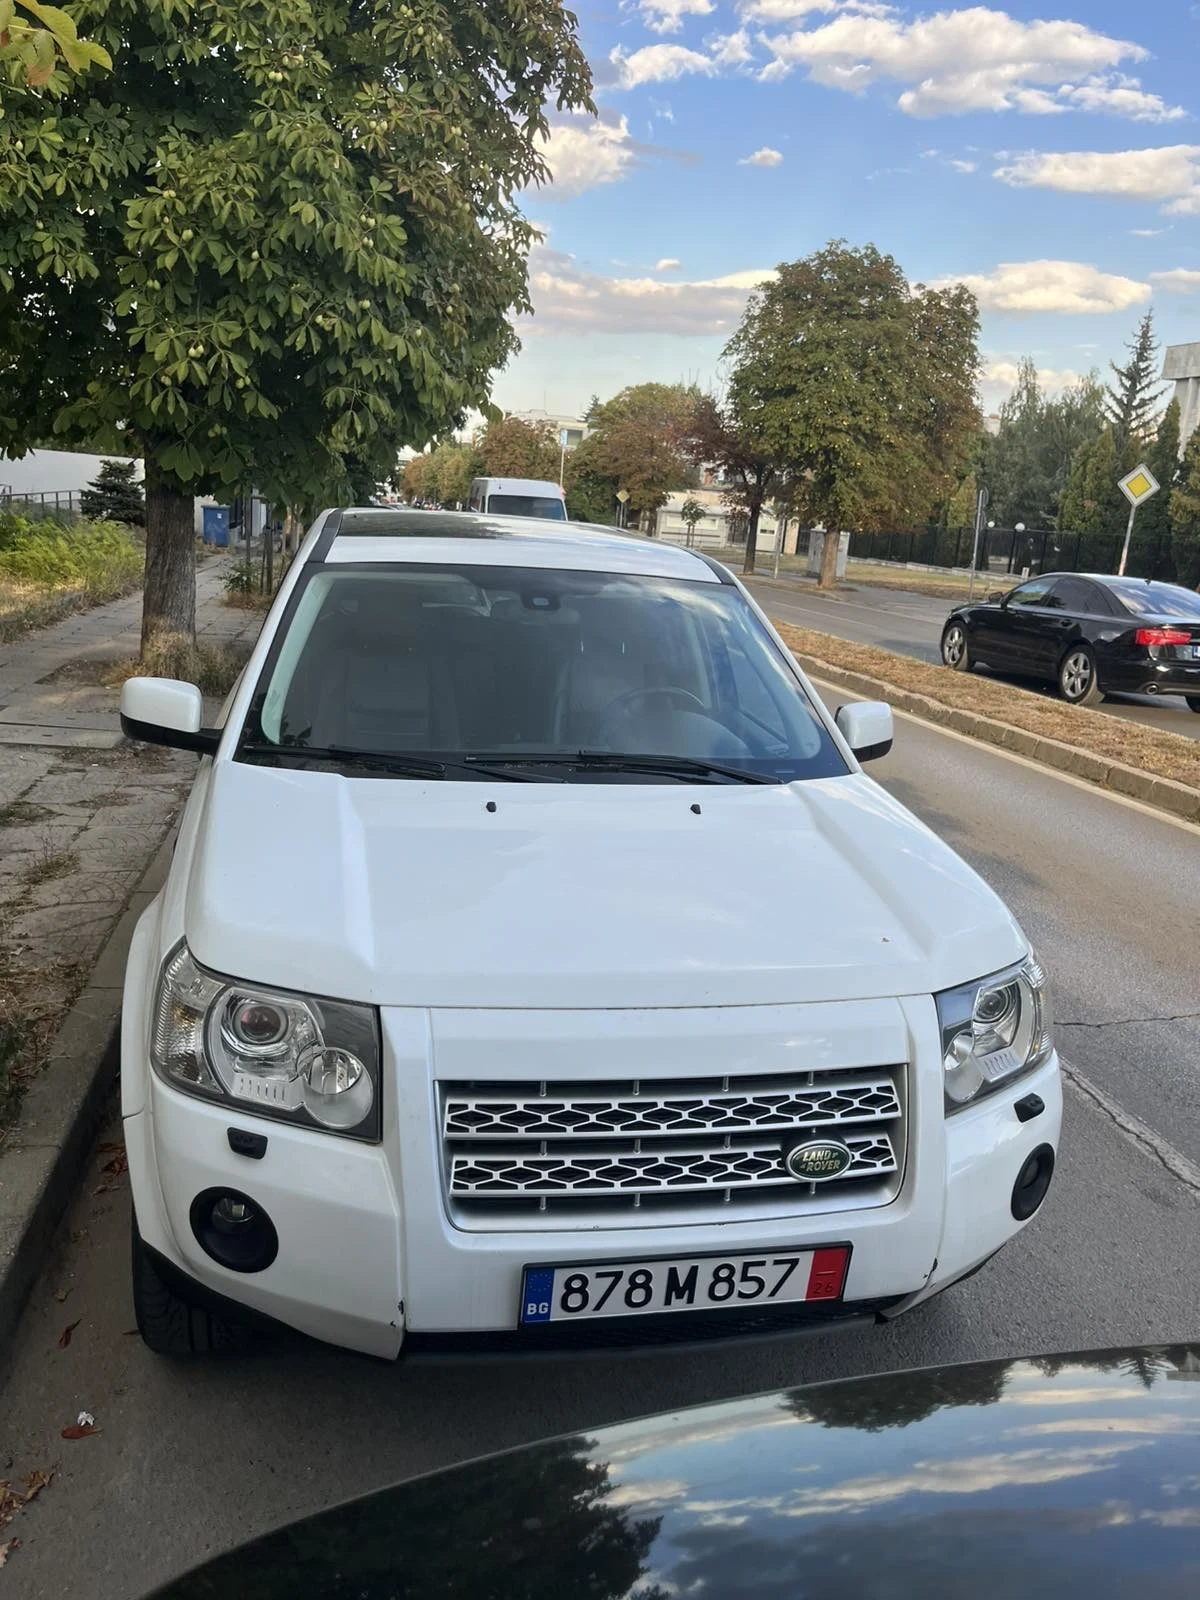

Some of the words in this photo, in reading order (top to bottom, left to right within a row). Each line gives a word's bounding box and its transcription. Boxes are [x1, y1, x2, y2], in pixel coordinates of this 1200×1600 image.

[803, 1150, 831, 1162] LAND
[806, 1160, 840, 1172] ROVER
[560, 1269, 653, 1313] 878
[664, 1265, 699, 1307] M
[708, 1258, 800, 1302] 857
[527, 1302, 549, 1316] BG
